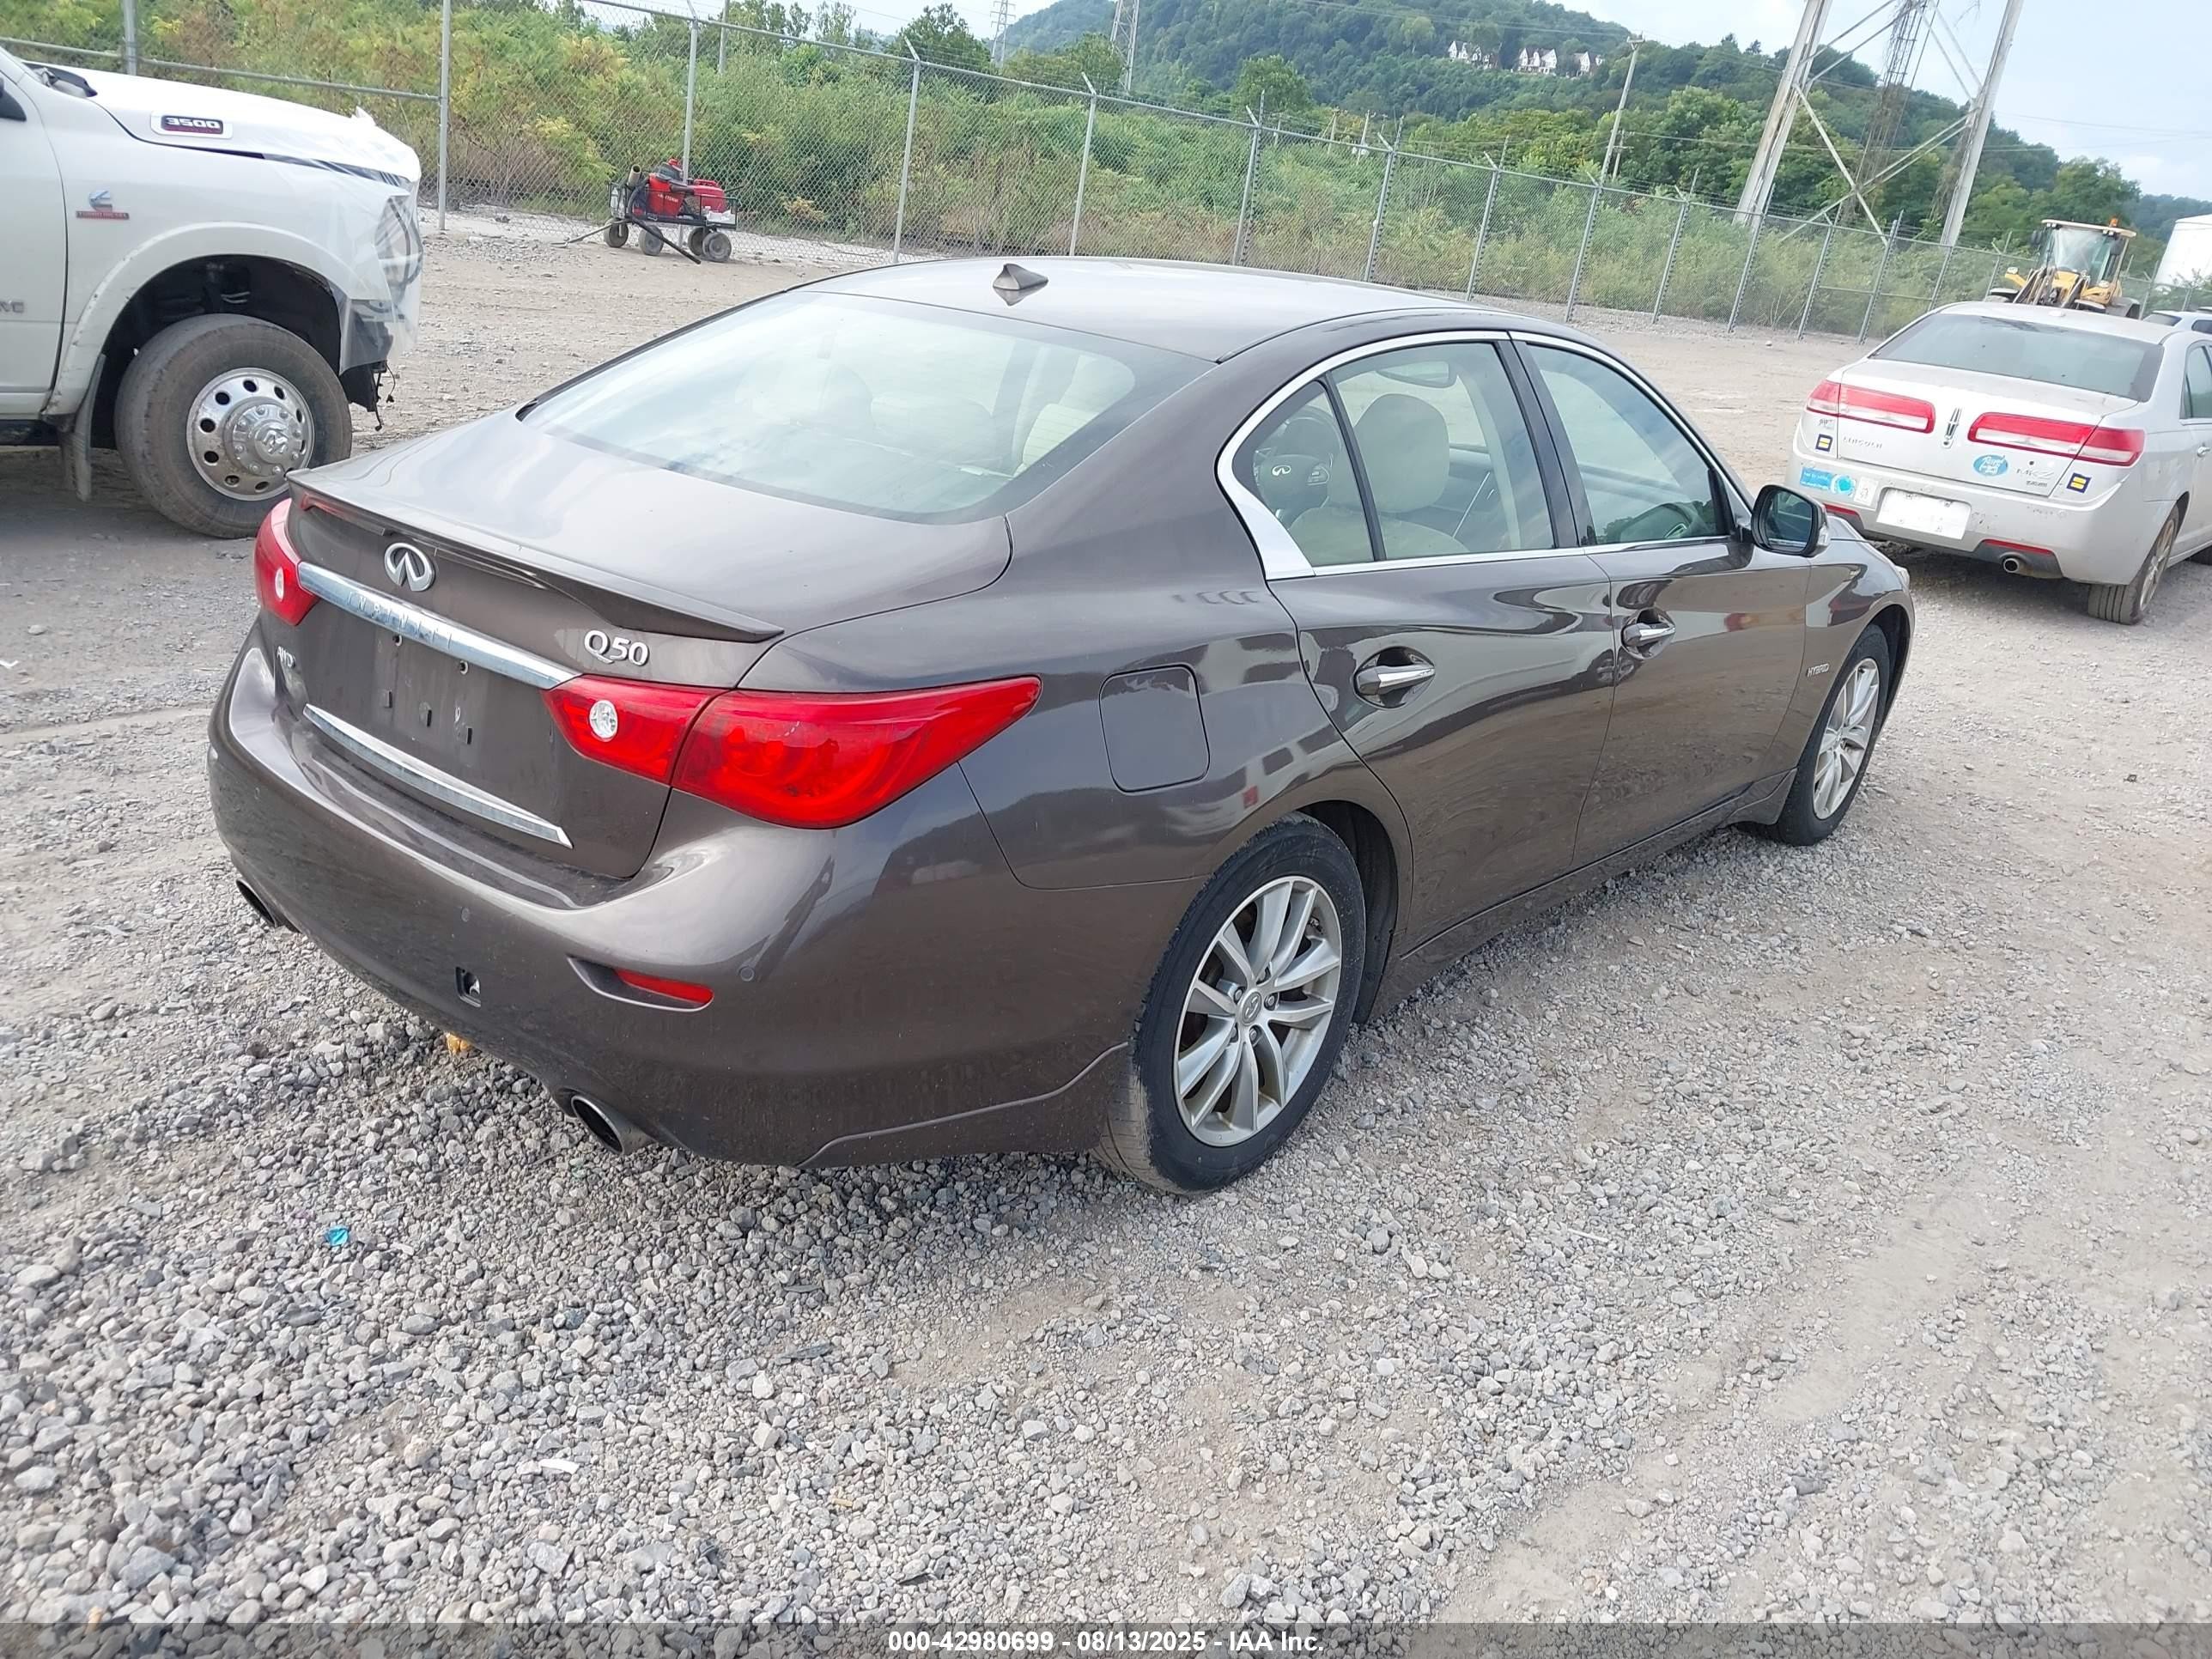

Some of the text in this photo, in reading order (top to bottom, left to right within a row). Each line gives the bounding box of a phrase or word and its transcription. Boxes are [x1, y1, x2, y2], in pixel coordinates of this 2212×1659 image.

[165, 117, 221, 130] 3500
[584, 629, 650, 666] Q50
[1806, 662, 1830, 678] HYBRID
